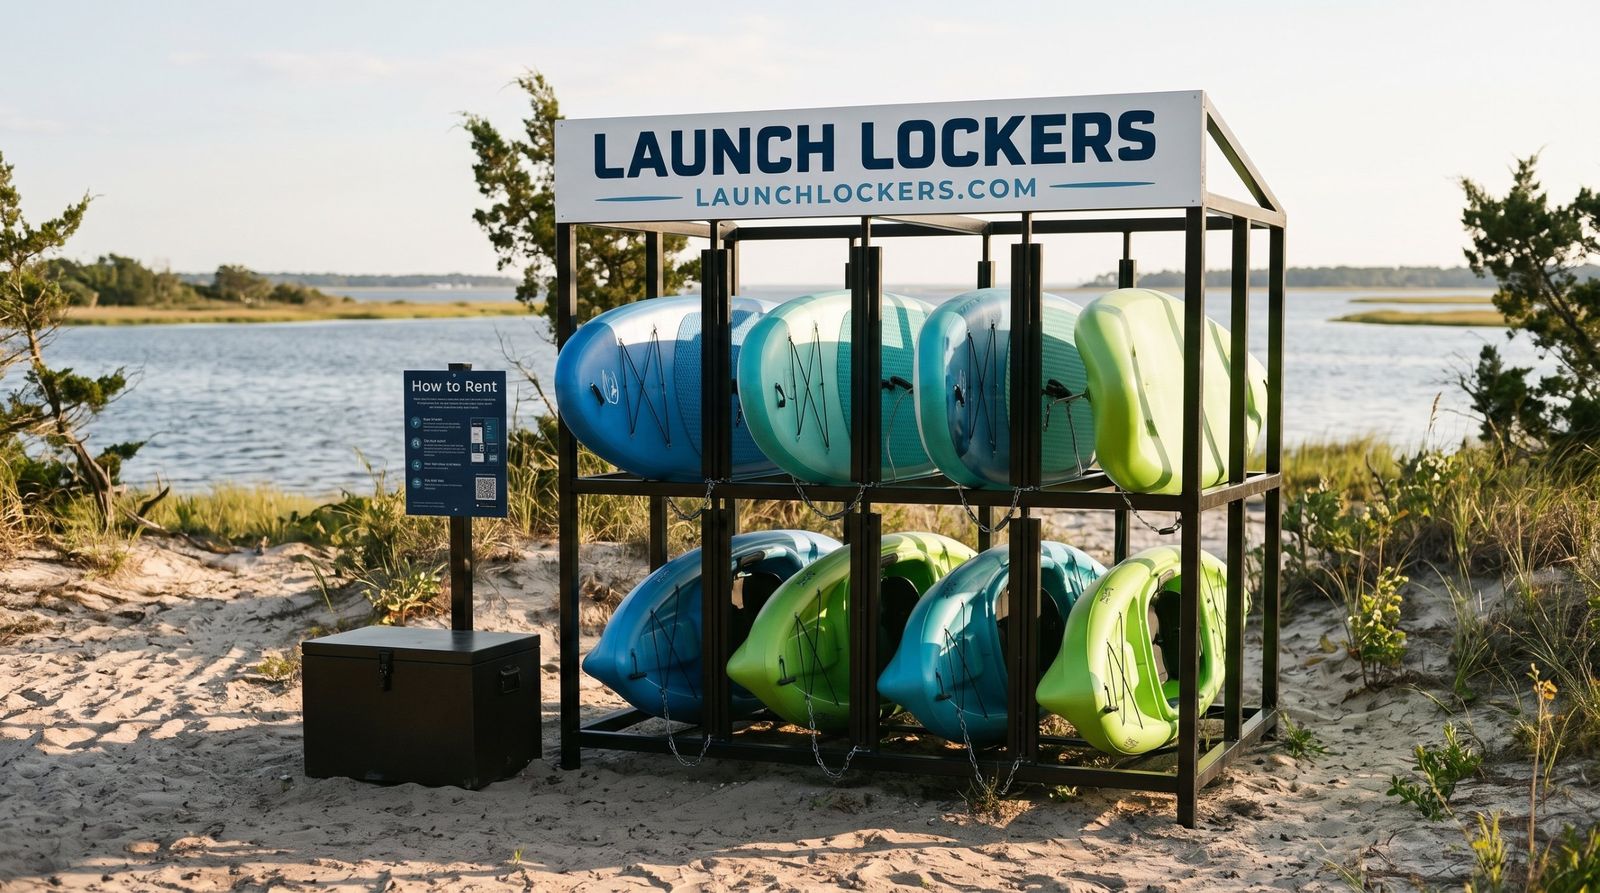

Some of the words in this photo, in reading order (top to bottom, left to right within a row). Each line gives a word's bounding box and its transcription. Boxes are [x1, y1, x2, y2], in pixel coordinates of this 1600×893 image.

[594, 123, 835, 180] LAUNCH
[861, 109, 1157, 171] LOCKERS
[696, 177, 1037, 207] LAUNCHLOCKERS.COM
[412, 380, 442, 392] How
[446, 380, 461, 392] to
[465, 380, 498, 393] Rent
